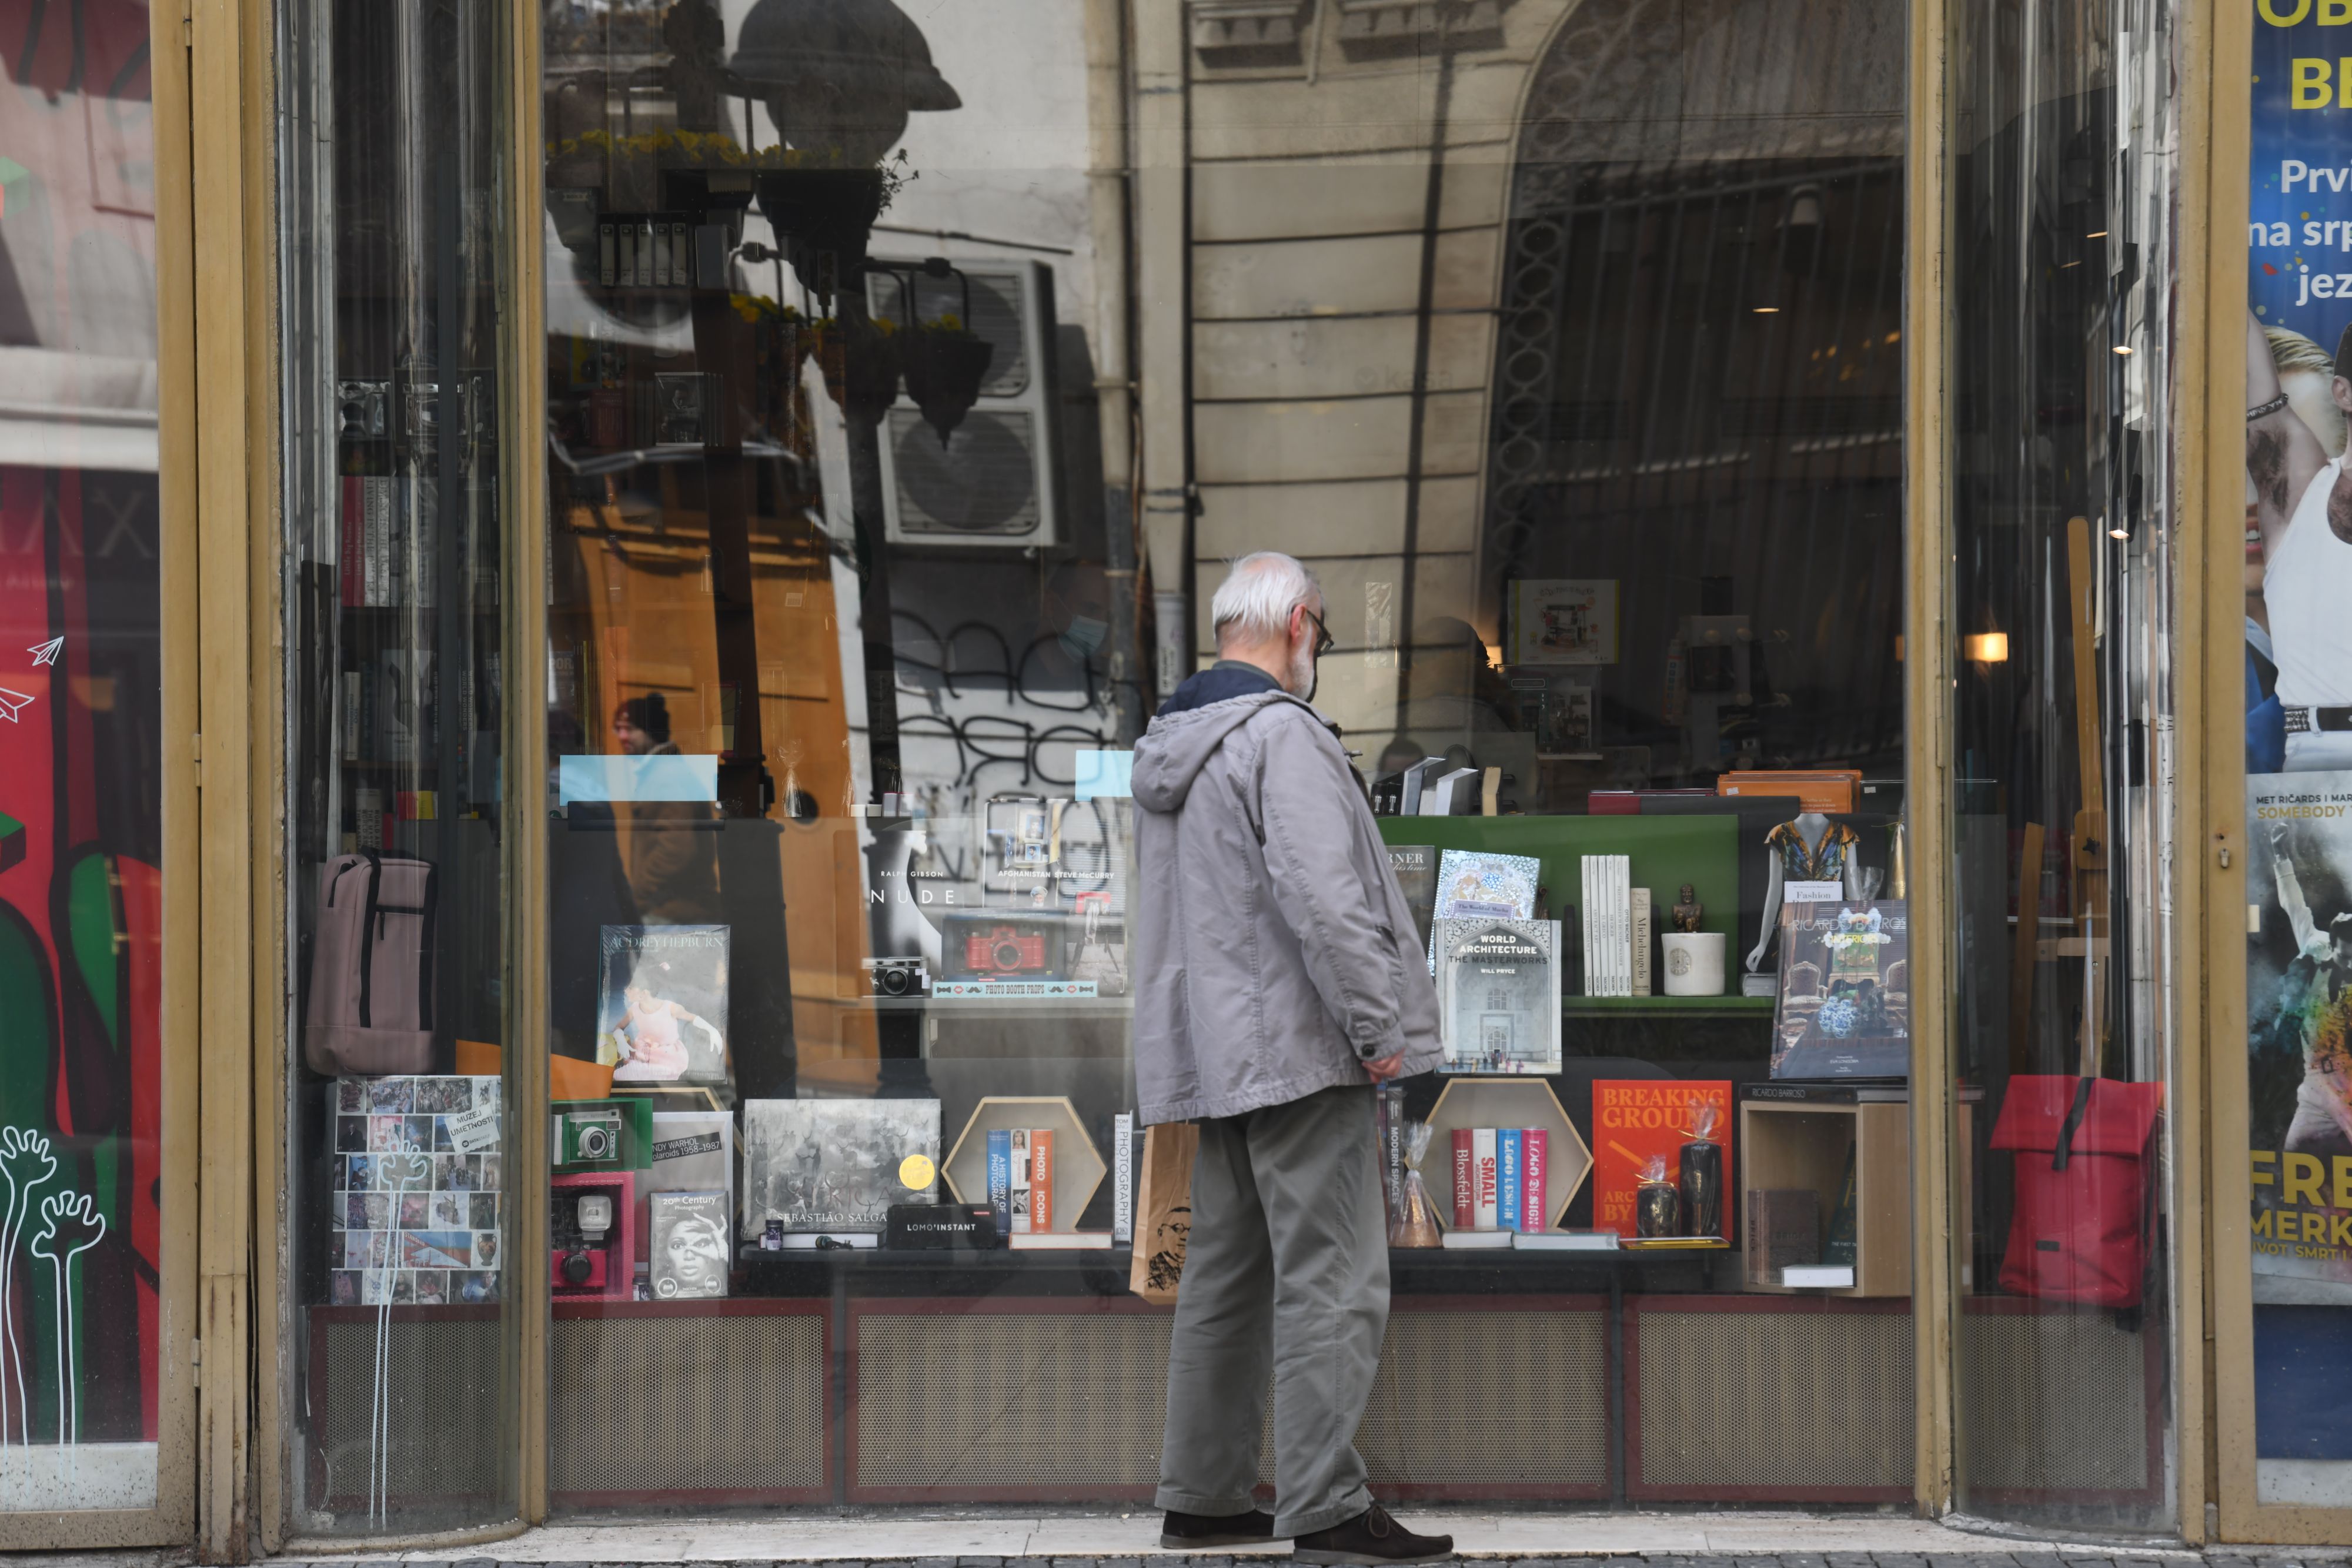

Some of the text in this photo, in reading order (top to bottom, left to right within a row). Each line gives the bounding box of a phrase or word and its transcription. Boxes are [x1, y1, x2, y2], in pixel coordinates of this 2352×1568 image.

[2281, 159, 2352, 193] Prv
[2249, 221, 2291, 246] na
[2296, 265, 2352, 306] jez
[367, 519, 373, 529] IN
[2256, 796, 2276, 804] MET
[2278, 794, 2321, 804] RIČARDS
[2257, 805, 2346, 819] SOMEBODY
[871, 890, 954, 904] NUDE
[1796, 891, 1831, 899] Fashion
[1792, 918, 1852, 931] RICARDO
[609, 935, 723, 948] AUDREY HEPBURN
[1480, 935, 1516, 944] WORLD
[1459, 945, 1538, 954] ARCHITECTURE
[1635, 917, 1647, 979] Michelangelo
[1472, 956, 1548, 965] MASTERWORKS
[985, 984, 1044, 994] PHOTO BOOTH PROPS
[1603, 1088, 1725, 1106] BREAKING
[1752, 1088, 1806, 1098] RICARDO BARROSO
[456, 1109, 482, 1124] MUZEJ
[450, 1116, 493, 1136] UMETNOSTI
[668, 1137, 700, 1149] WARHOL
[1391, 1126, 1399, 1166] MODERN
[653, 1149, 680, 1160] olaroids
[1504, 1139, 1514, 1175] LOGO
[1037, 1146, 1045, 1223] PHOTO ICONS
[1119, 1131, 1128, 1224] PHOTOGRAPHY
[1456, 1149, 1470, 1209] Blossfeldt
[1481, 1157, 1495, 1208] SMALL
[1528, 1139, 1540, 1225] LOGO DESIGN
[663, 1196, 716, 1206] 20th Century
[1604, 1191, 1635, 1203] ARC
[999, 1202, 1005, 1213] OF
[1604, 1204, 1631, 1221] BY
[777, 1211, 843, 1222] SEBASTIÃO
[2251, 1209, 2352, 1247] MERK
[405, 1232, 425, 1246] STANDARD
[2295, 1245, 2338, 1261] SMRT
